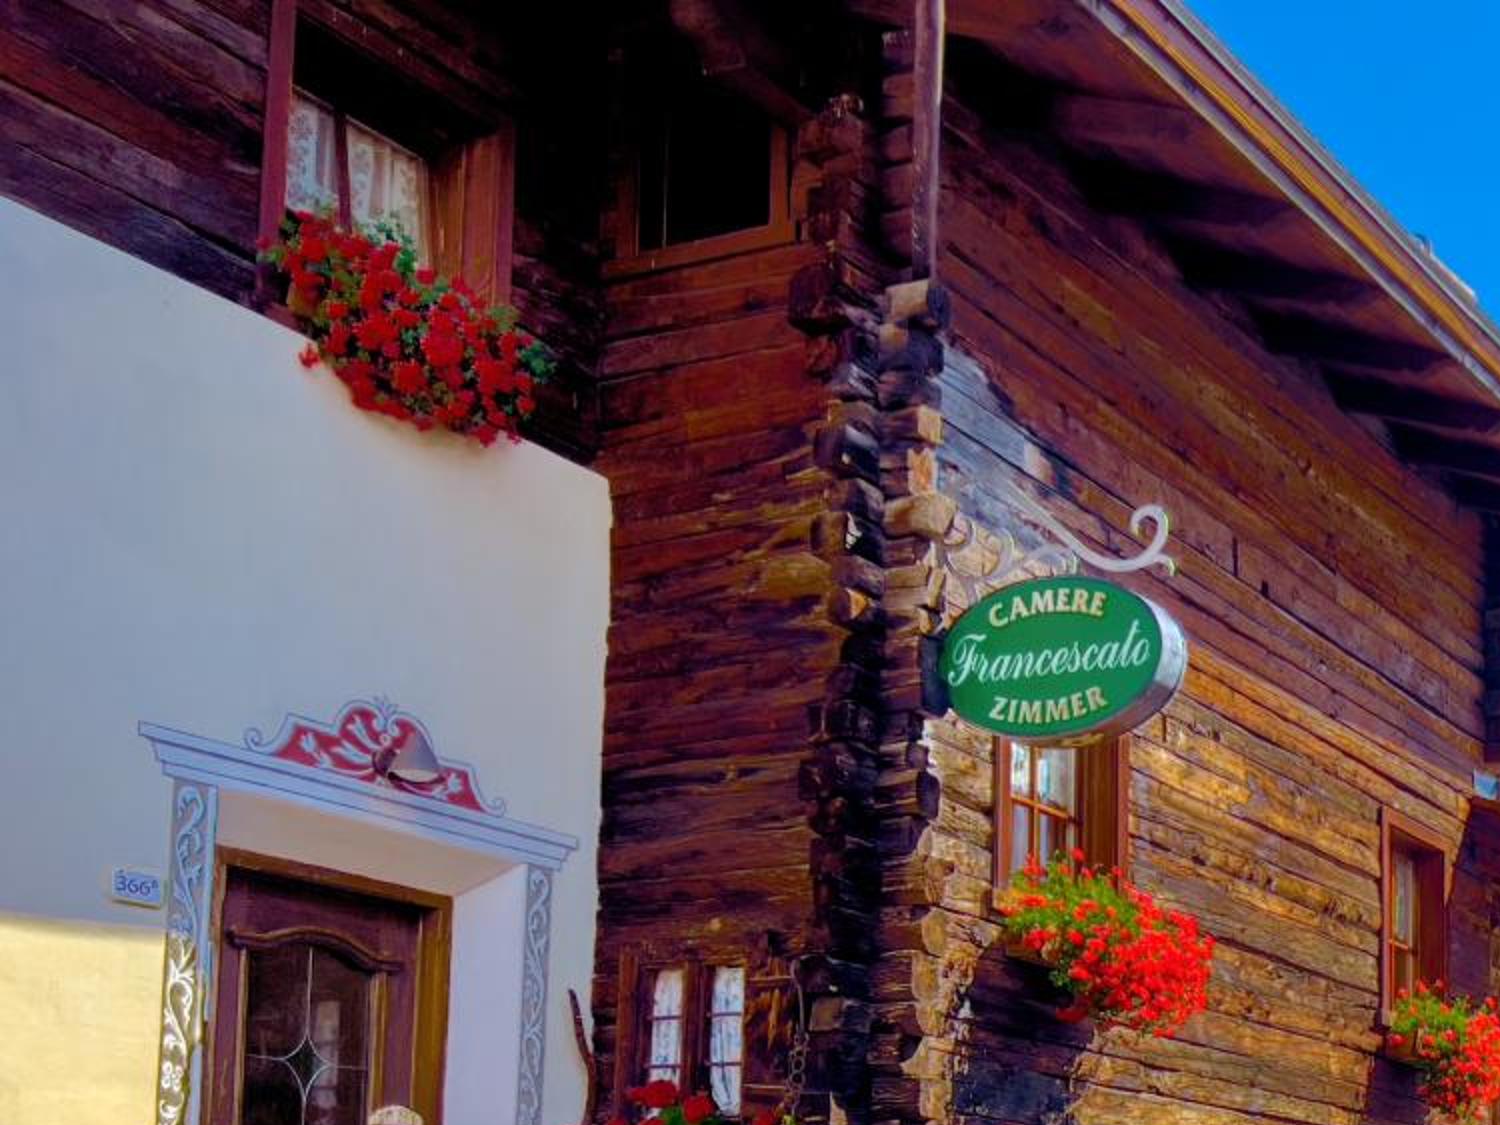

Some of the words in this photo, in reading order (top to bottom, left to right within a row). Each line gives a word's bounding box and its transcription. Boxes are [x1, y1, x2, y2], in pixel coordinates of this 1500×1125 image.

[988, 587, 1107, 627] CAMERE
[947, 618, 1151, 687] Francescato
[988, 686, 1108, 725] ZIMMER
